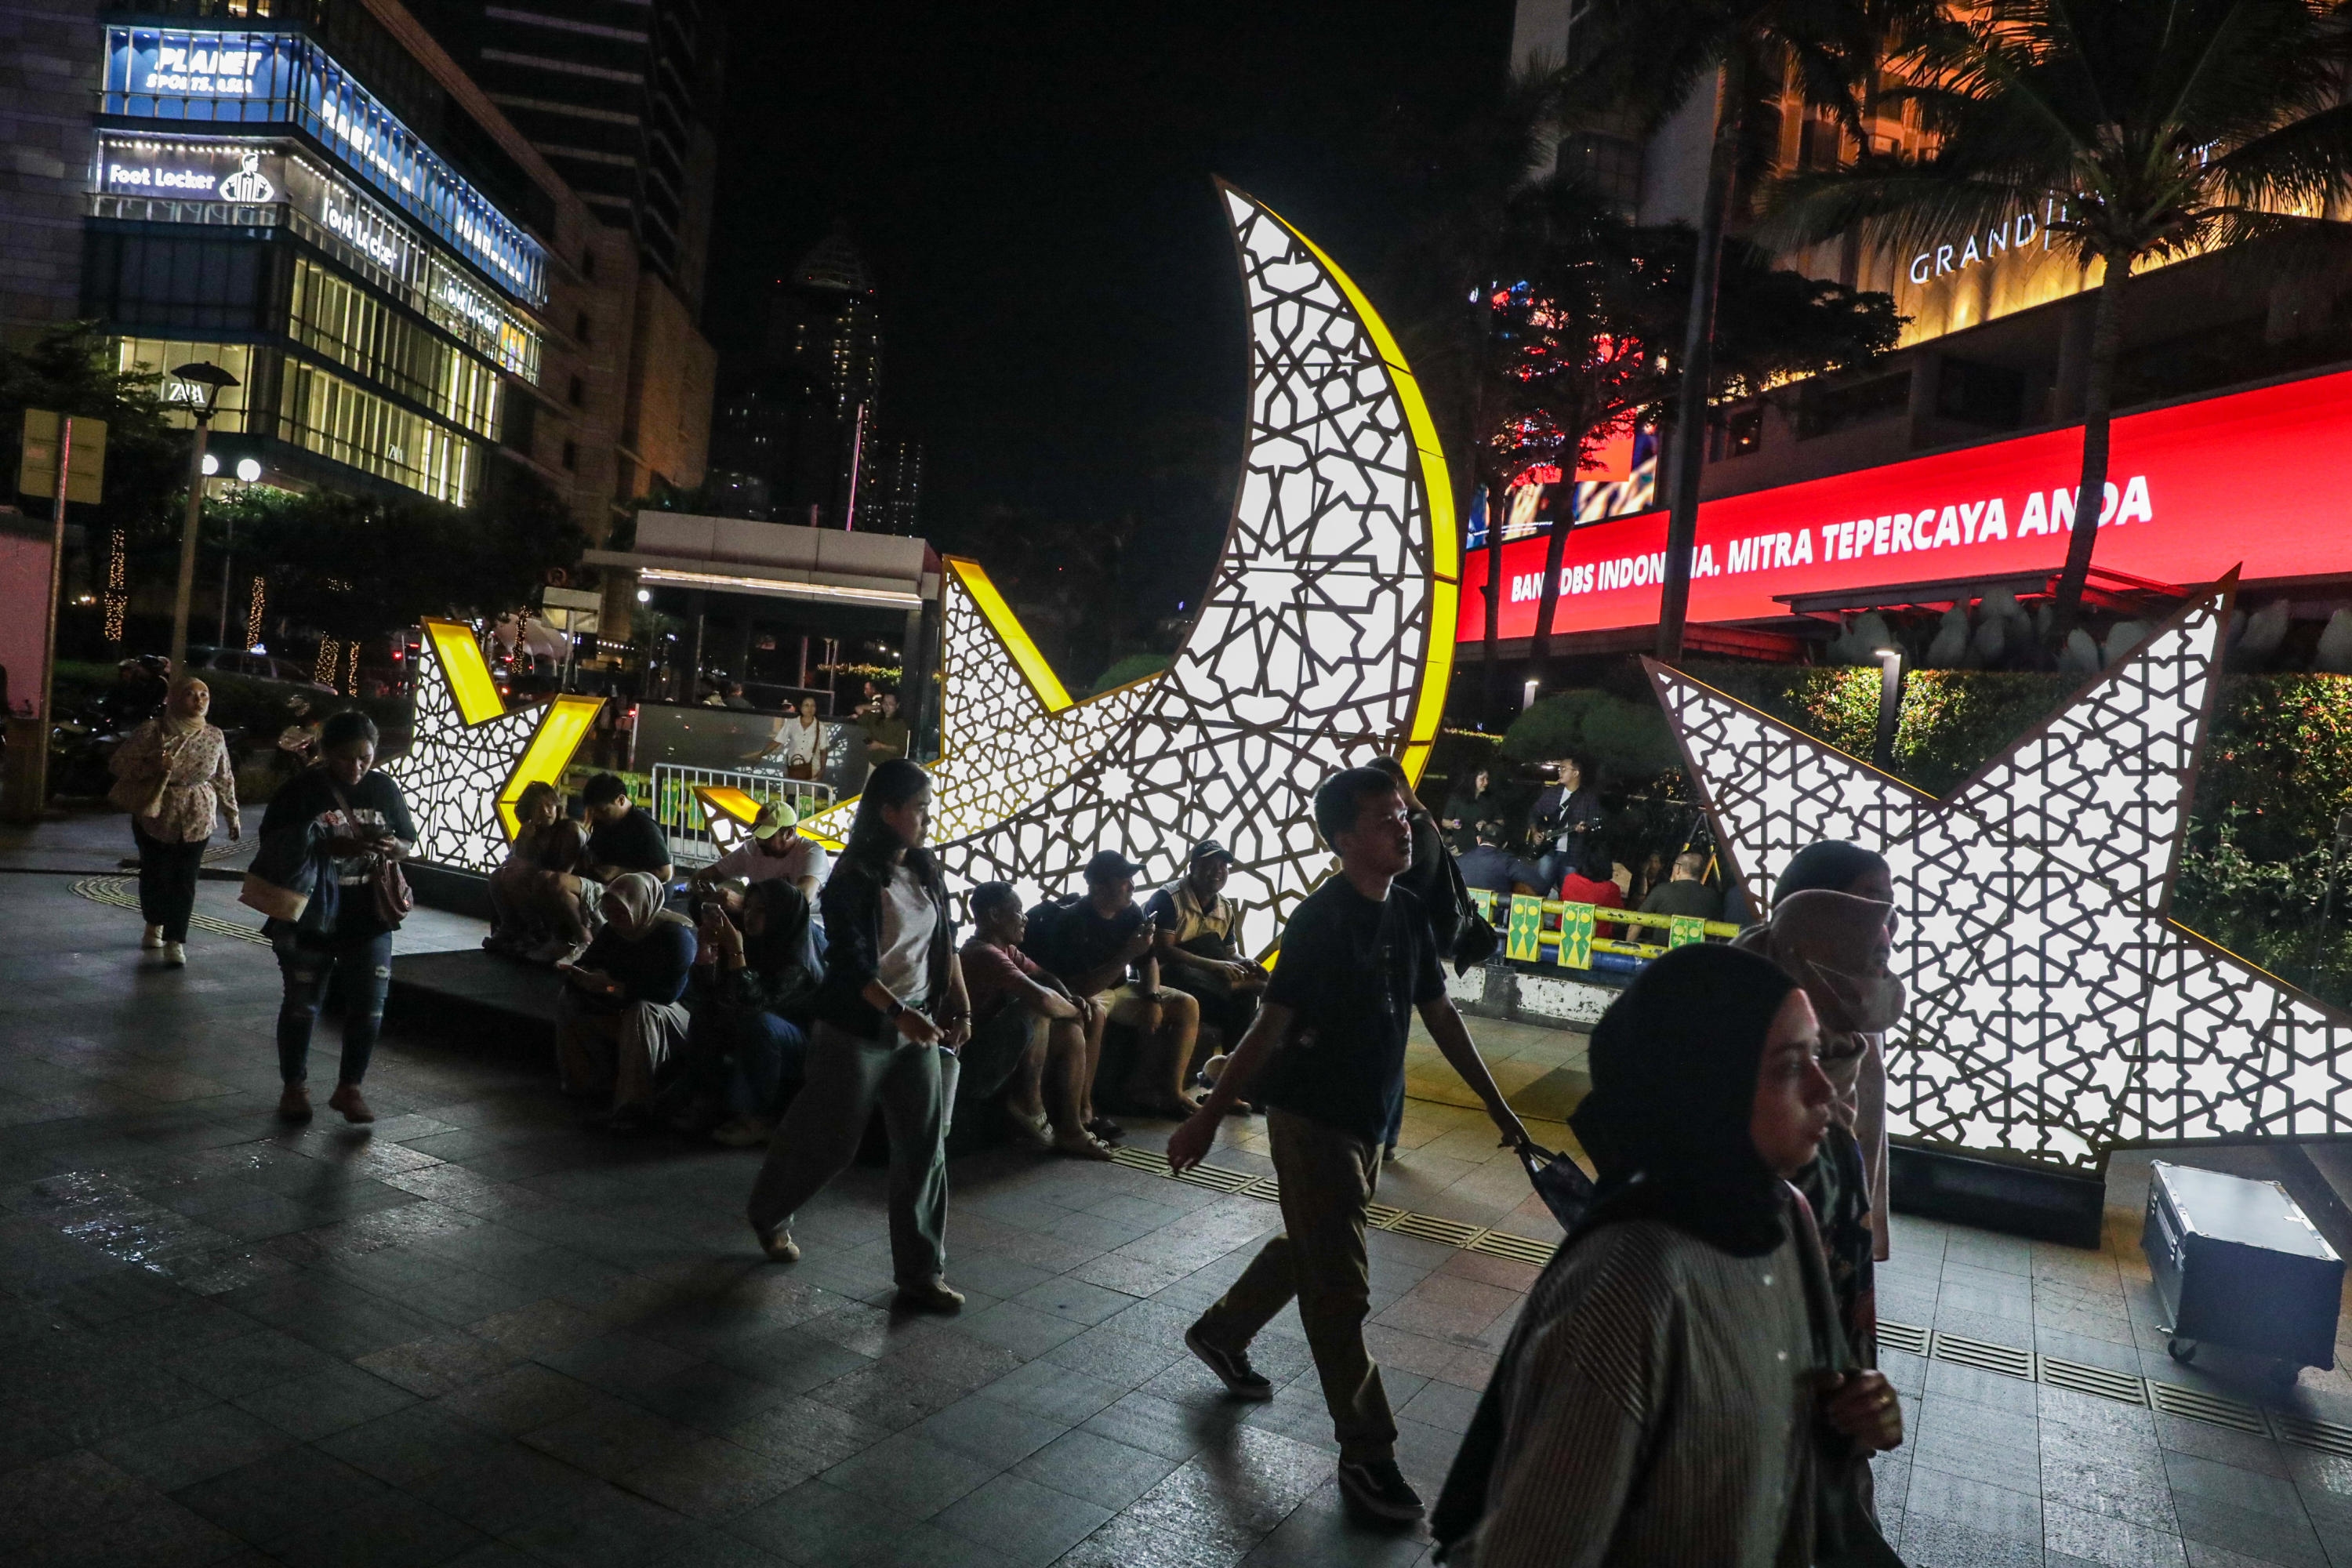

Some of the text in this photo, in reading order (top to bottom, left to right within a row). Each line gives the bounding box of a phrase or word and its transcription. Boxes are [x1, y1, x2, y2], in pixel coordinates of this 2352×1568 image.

[154, 47, 262, 75] PLANET
[110, 164, 216, 190] Foot Locker
[1910, 212, 2036, 285] GRAND
[1512, 474, 2153, 602] BAN DBS INDONIA. MITRA TEPERCAYA ANDA
